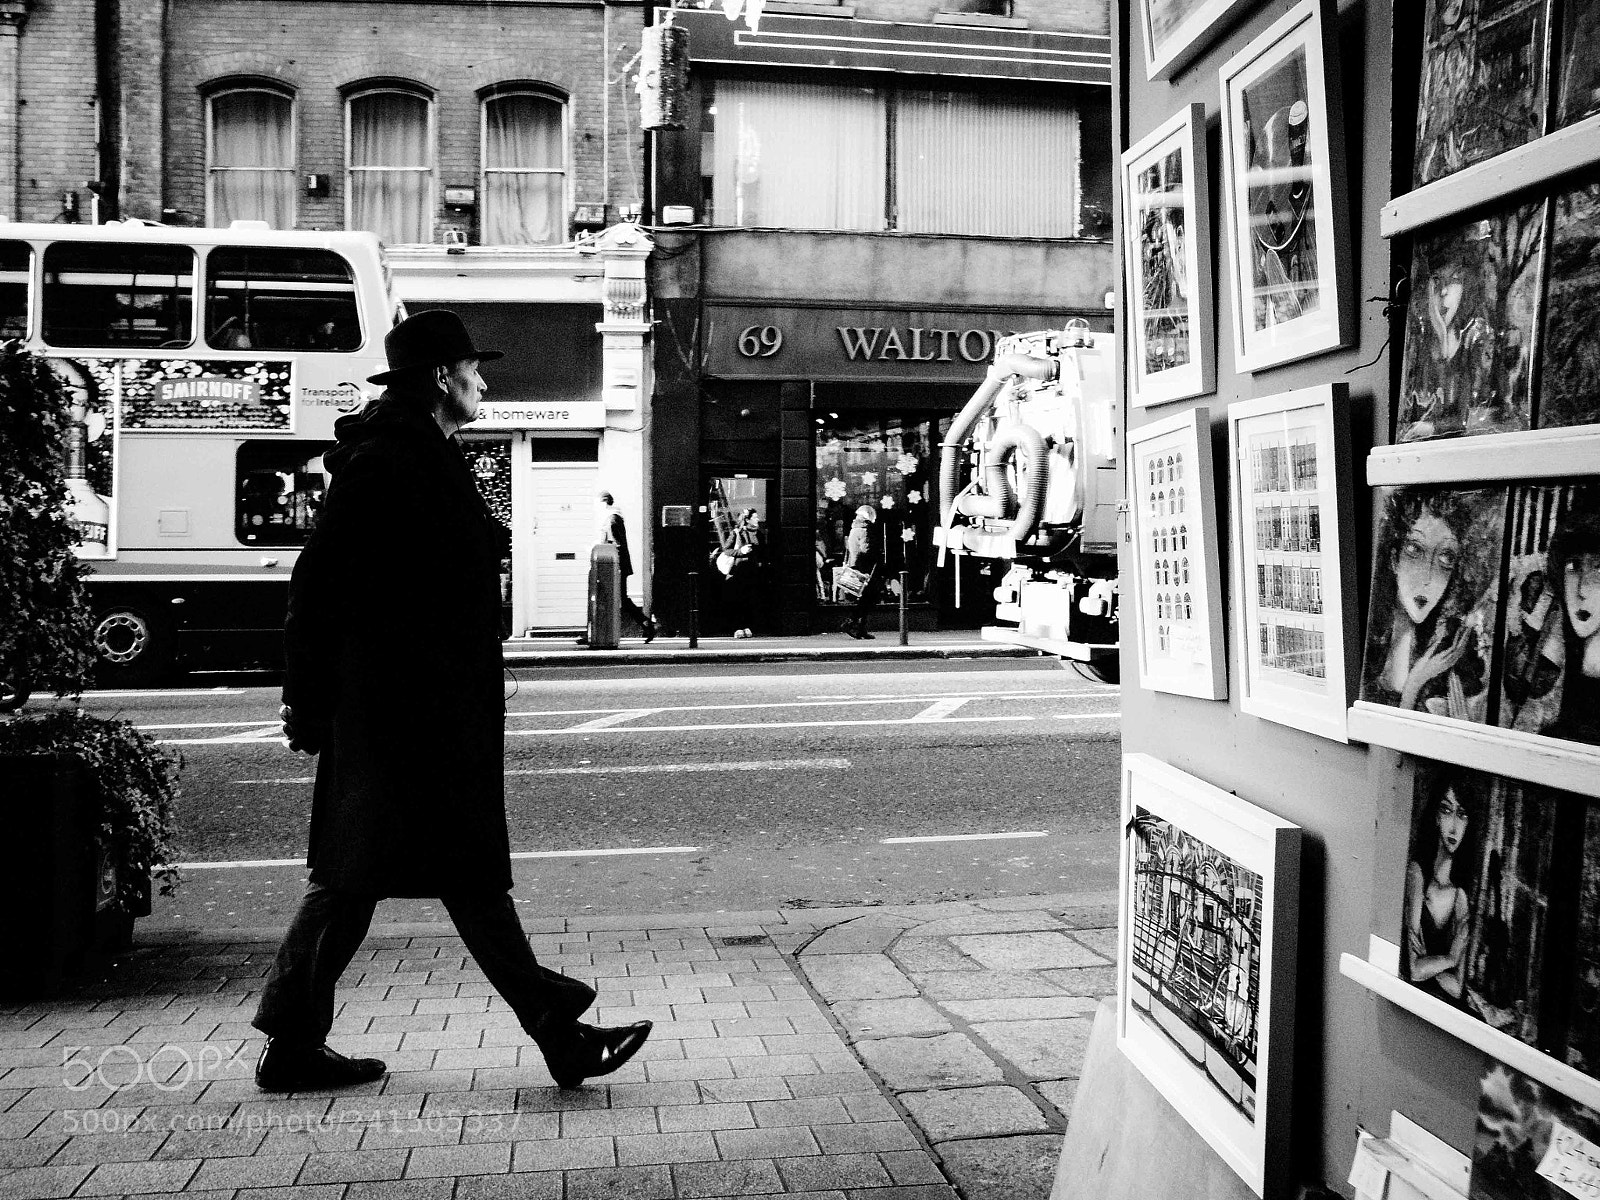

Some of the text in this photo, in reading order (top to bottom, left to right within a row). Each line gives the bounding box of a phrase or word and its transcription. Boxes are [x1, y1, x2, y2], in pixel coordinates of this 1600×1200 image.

[738, 325, 783, 357] 69
[161, 381, 254, 400] SMIRNOFF
[301, 387, 354, 396] Transport
[492, 407, 570, 420] homeware
